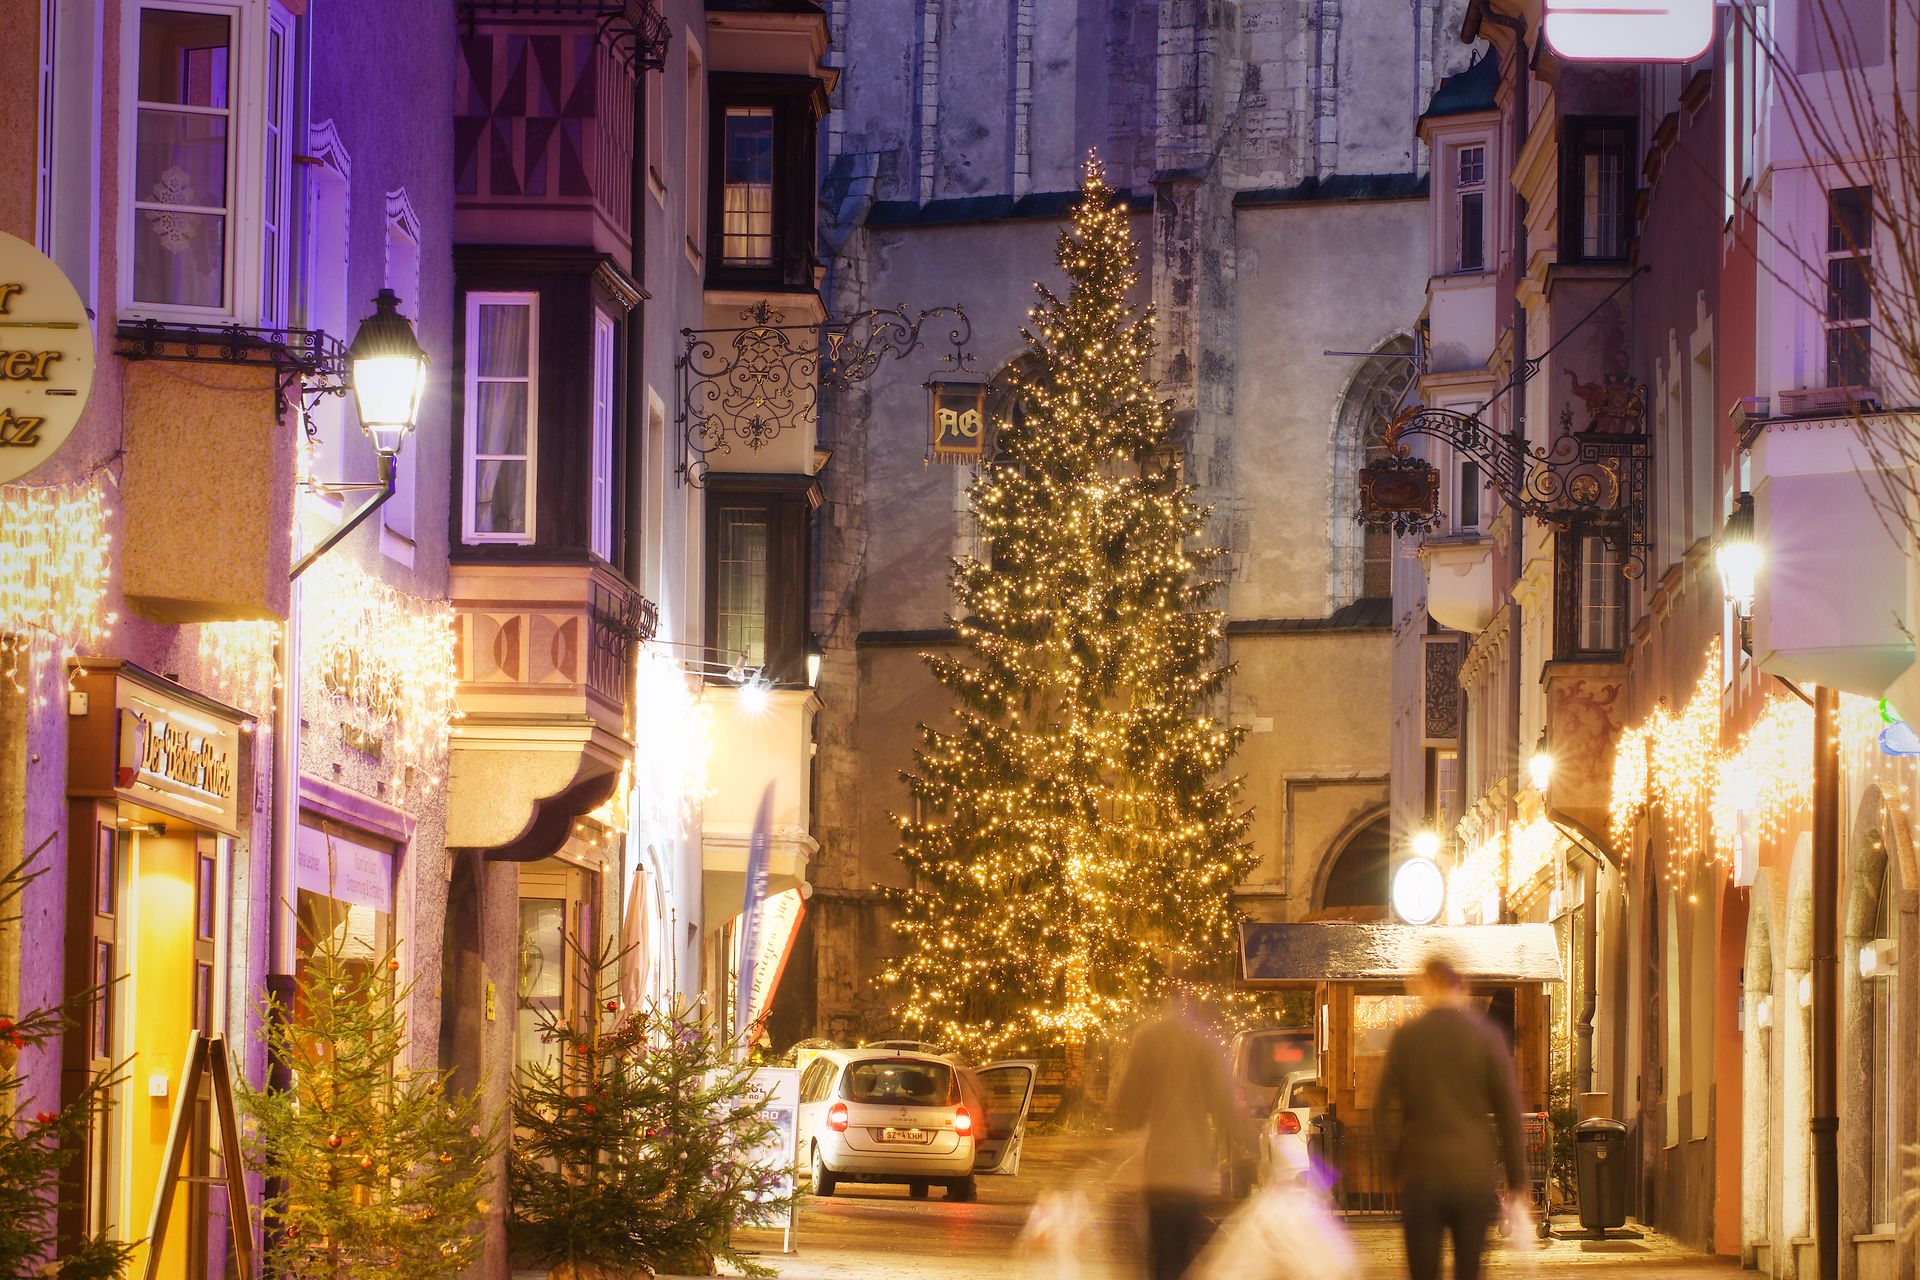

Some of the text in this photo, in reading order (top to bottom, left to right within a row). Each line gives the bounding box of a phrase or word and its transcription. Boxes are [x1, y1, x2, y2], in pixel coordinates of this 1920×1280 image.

[140, 713, 230, 799] Der Bäcker Ruetz
[886, 1131, 897, 1139] SZ
